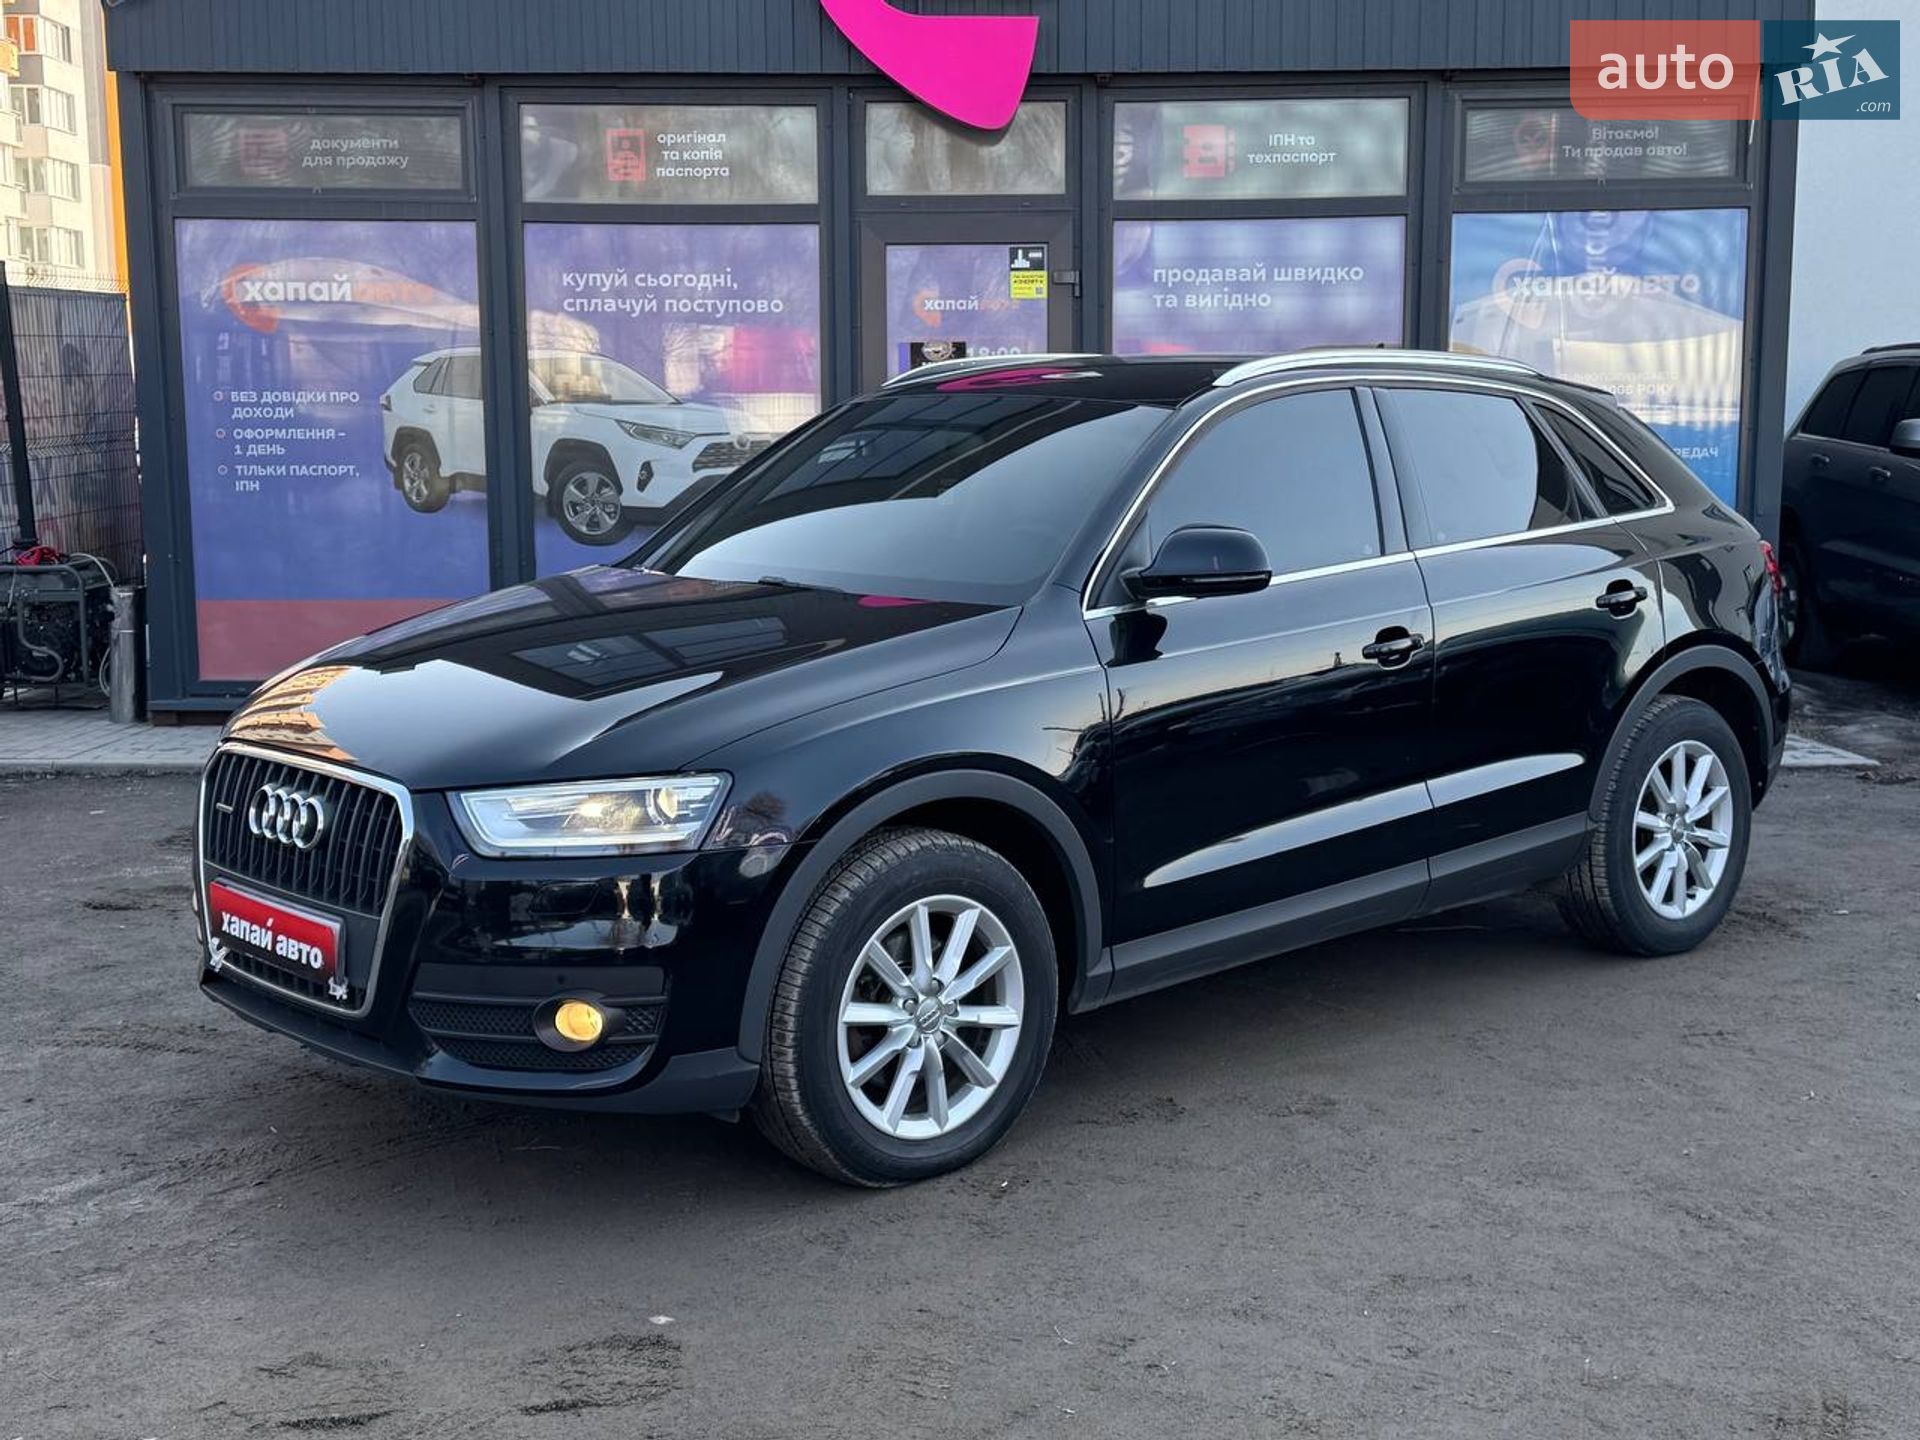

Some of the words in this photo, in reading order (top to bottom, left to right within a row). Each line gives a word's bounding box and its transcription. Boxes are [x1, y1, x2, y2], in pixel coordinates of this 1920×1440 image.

[657, 131, 726, 146] оригінал
[1269, 134, 1295, 146] ІПН
[1297, 135, 1315, 146] та
[1592, 127, 1659, 141] Вітаємо!
[310, 138, 399, 152] документи
[1562, 146, 1581, 157] Ти
[1585, 146, 1643, 161] продав
[1647, 143, 1688, 157] авто!
[662, 149, 680, 160] та
[683, 147, 722, 161] копія
[1248, 152, 1337, 165] техпаспорт
[302, 156, 333, 168] для
[336, 156, 409, 169] продажу
[656, 166, 730, 180] паспорта
[562, 268, 628, 291] купуй
[635, 267, 738, 290] сьогодні,
[1153, 263, 1266, 286] продавай
[1273, 266, 1364, 285] швидко
[243, 274, 352, 301] хапай
[563, 294, 657, 317] сплачуй
[664, 298, 783, 317] поступово
[924, 295, 979, 311] хапай
[1153, 294, 1178, 308] та
[1185, 288, 1271, 309] вигідно
[231, 391, 259, 402] БЕЗ
[262, 391, 325, 404] ДОВІДКИ
[329, 391, 360, 402] ПРО
[231, 407, 294, 419] ДОХОДИ
[233, 428, 335, 440] ОФОРМЛЕННЯ
[234, 444, 242, 455] 1
[246, 444, 286, 457] ДЕНЬ
[236, 465, 287, 476] ТІЛЬКИ
[235, 480, 260, 491] ІПН
[221, 911, 273, 951] хапай
[276, 933, 324, 969] авто
